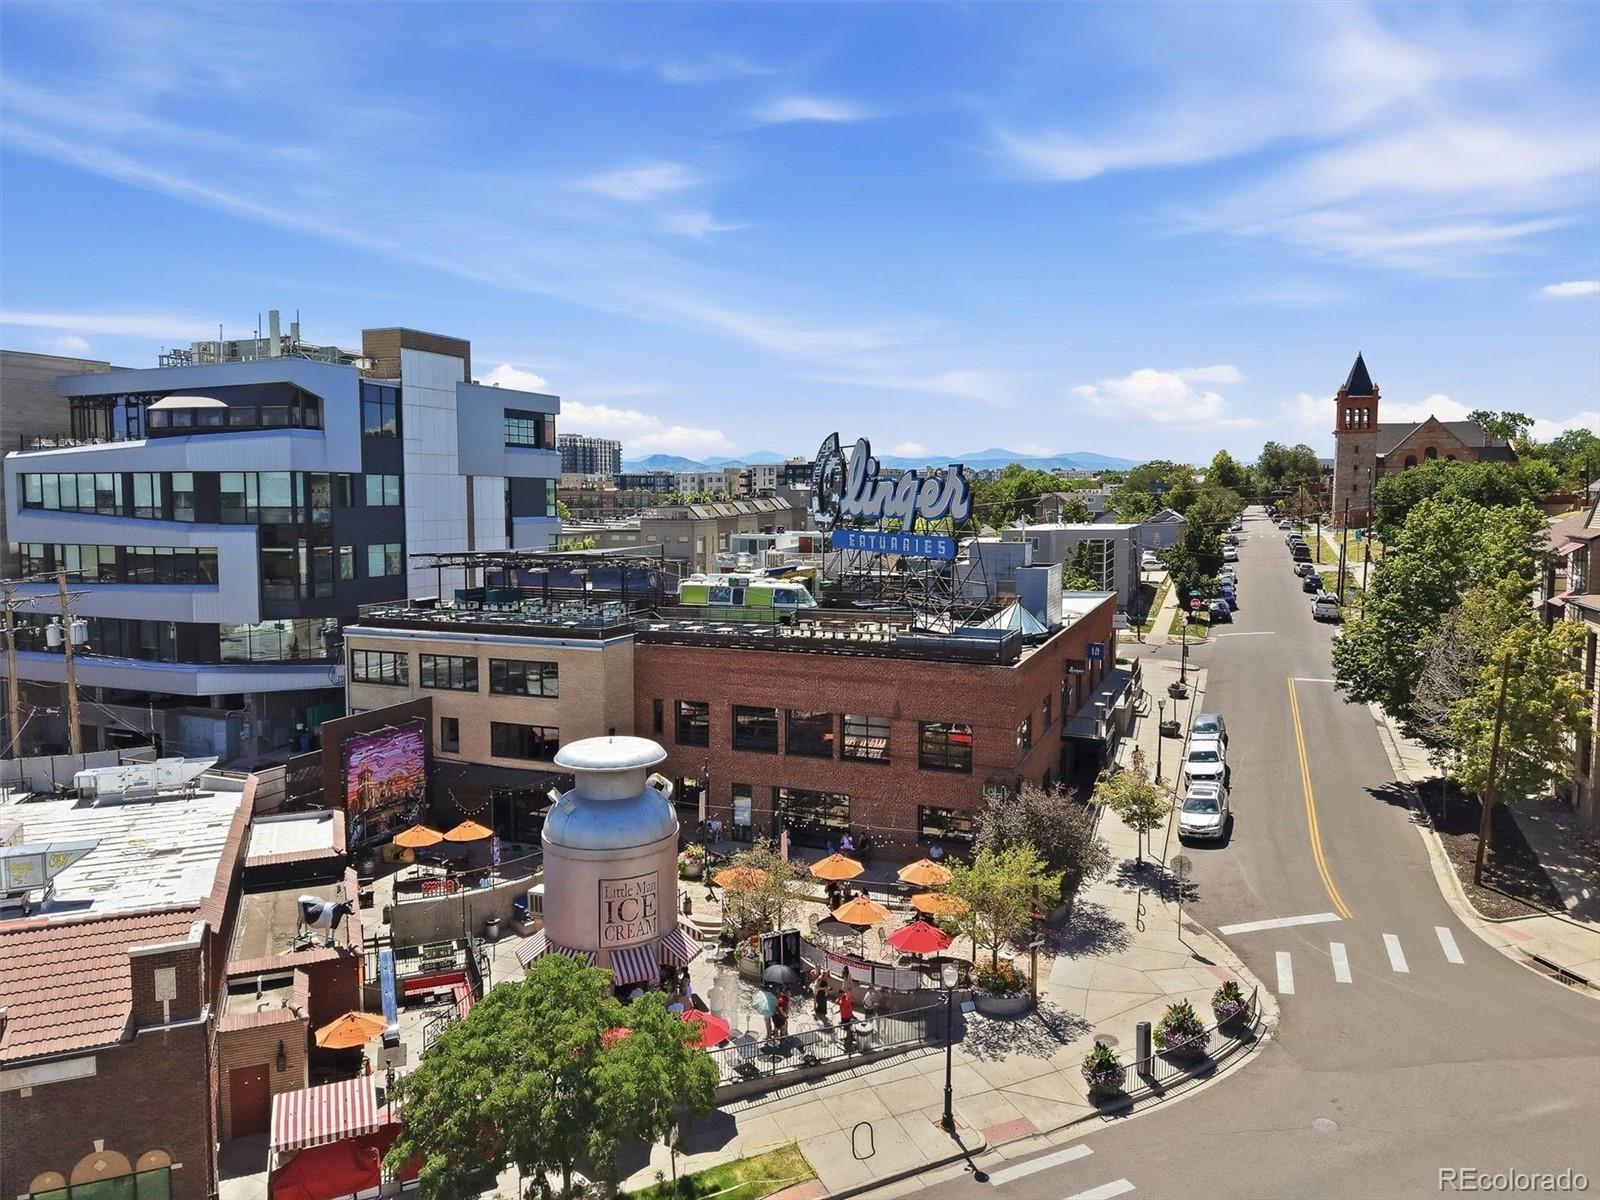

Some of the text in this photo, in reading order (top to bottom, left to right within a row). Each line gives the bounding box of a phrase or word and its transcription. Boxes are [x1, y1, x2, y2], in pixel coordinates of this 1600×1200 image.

[604, 880, 656, 899] Little Man
[604, 892, 657, 924] ICE
[604, 917, 657, 941] CREAM
